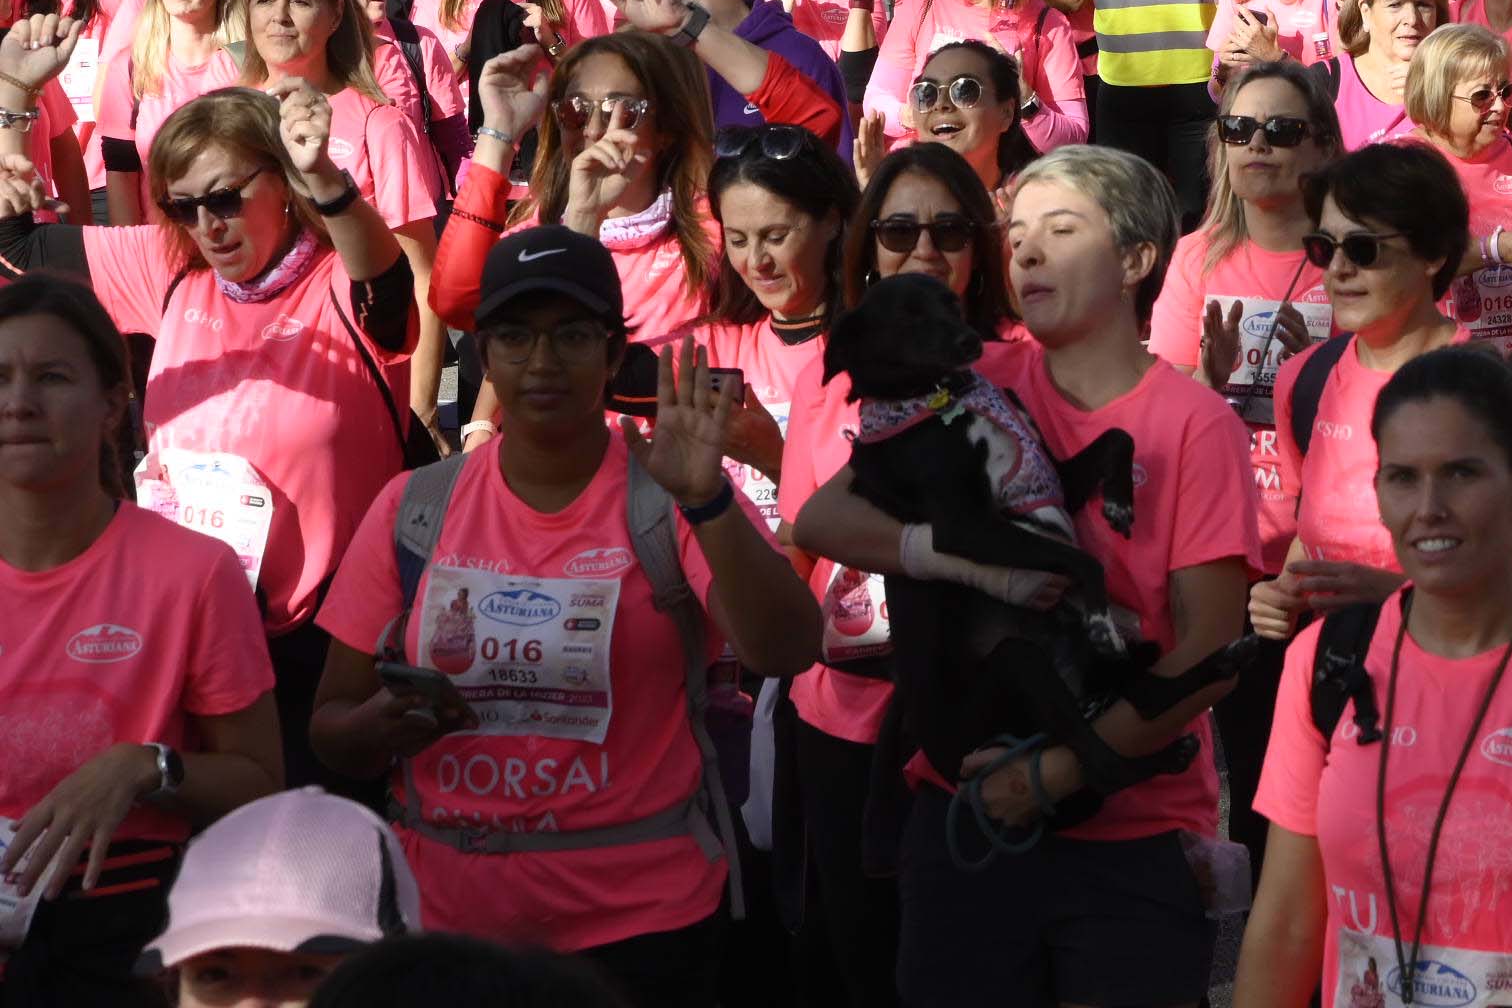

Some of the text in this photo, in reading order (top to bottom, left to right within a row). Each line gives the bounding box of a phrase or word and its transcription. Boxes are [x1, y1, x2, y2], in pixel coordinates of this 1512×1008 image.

[184, 505, 224, 528] 016
[760, 508, 773, 516] DE
[571, 555, 629, 572] ASTURIANA
[485, 598, 554, 618] ASTURIANA
[569, 599, 604, 608] SUMA
[71, 638, 139, 656] ASTURIANA
[481, 637, 543, 662] 016
[488, 669, 538, 683] 18633
[543, 713, 599, 728] Santander
[1393, 976, 1469, 1000] TURIANA
